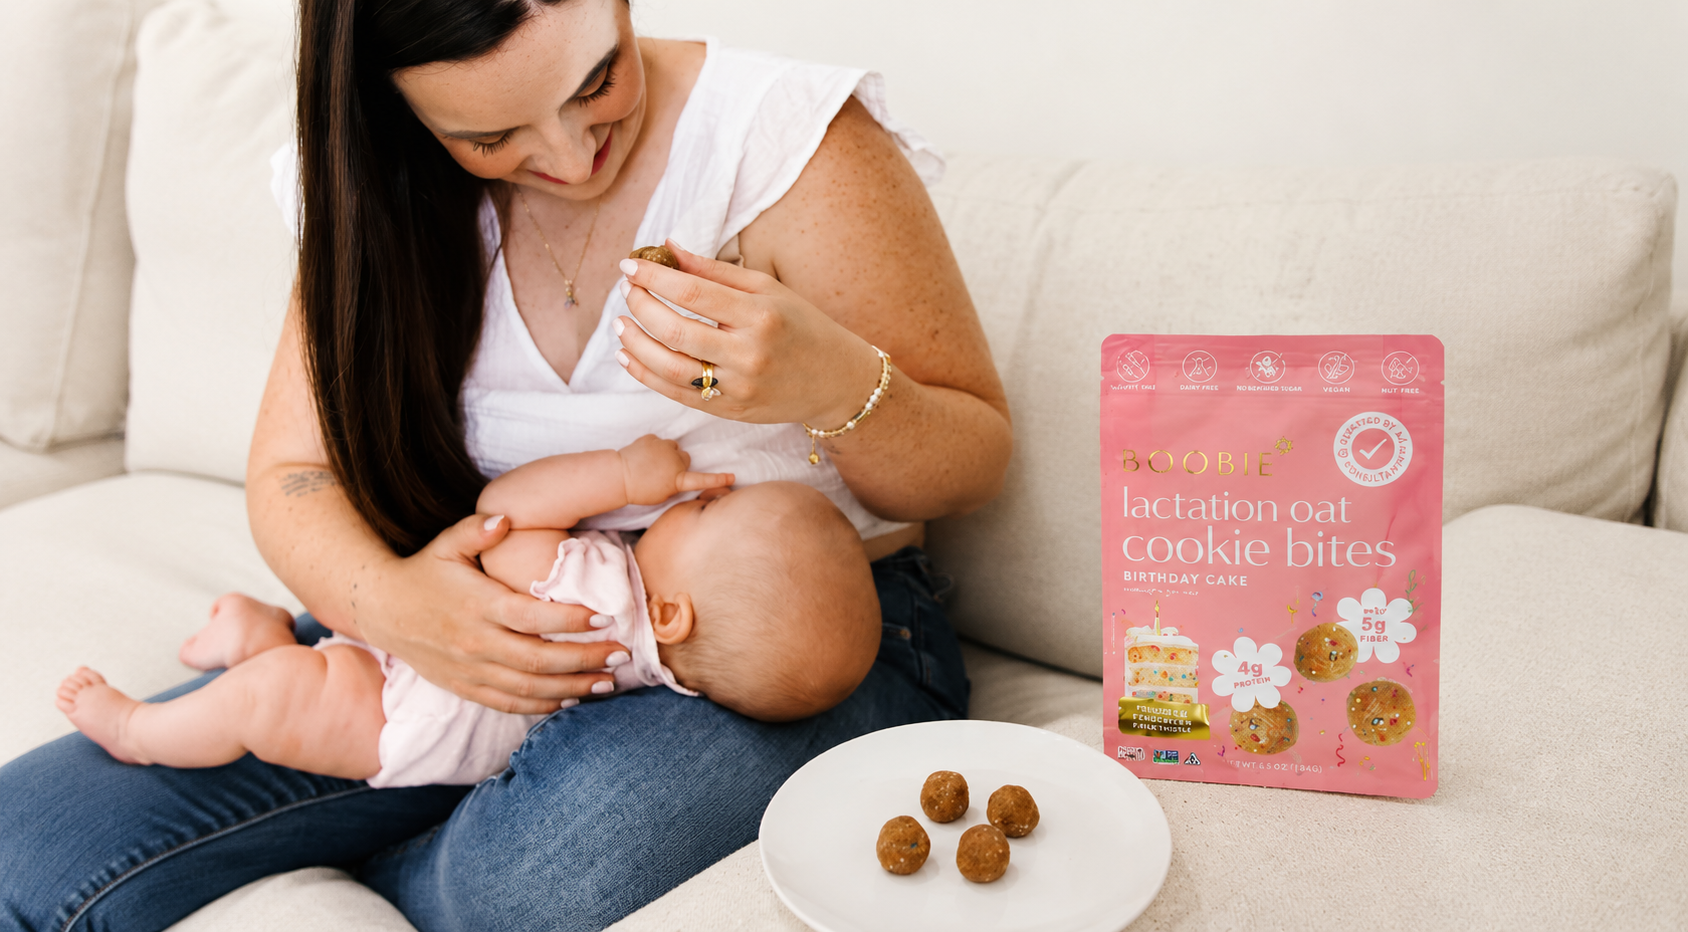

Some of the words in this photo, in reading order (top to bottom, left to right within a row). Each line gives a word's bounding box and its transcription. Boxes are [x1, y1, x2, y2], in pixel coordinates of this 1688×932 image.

[1122, 449, 1273, 476] BOOBIE
[1123, 485, 1278, 522] lactation
[1290, 496, 1352, 523] oat
[1122, 525, 1270, 567] cookie
[1287, 527, 1397, 567] bites
[1123, 571, 1200, 585] BIRTHDAY
[1206, 574, 1248, 586] CAKE
[1361, 616, 1386, 634] 5g
[1237, 661, 1263, 677] 4g
[1233, 676, 1271, 689] PROTEIN
